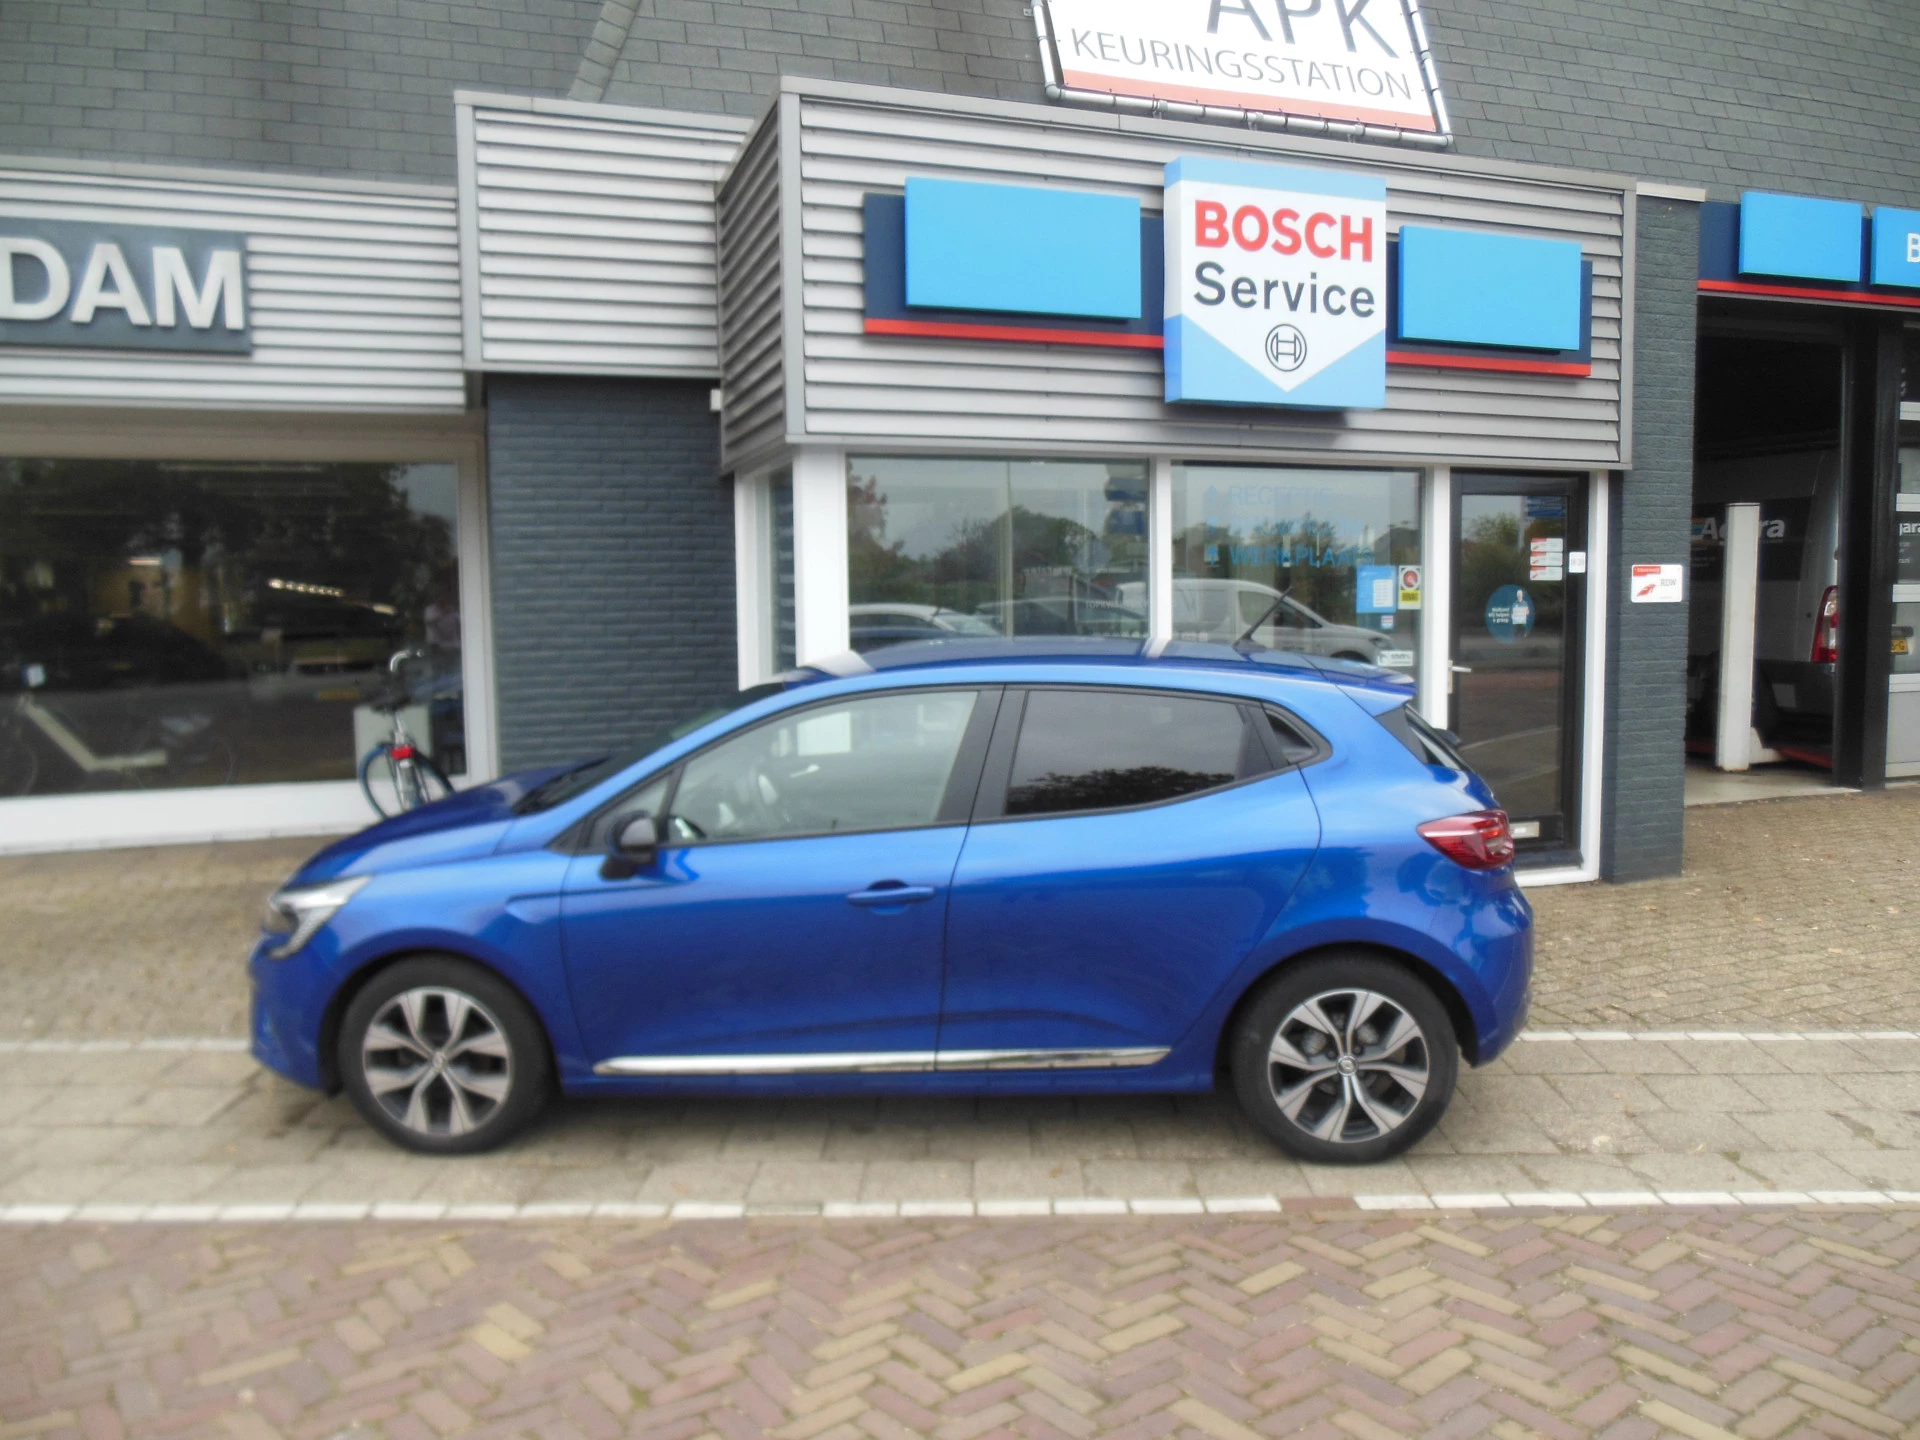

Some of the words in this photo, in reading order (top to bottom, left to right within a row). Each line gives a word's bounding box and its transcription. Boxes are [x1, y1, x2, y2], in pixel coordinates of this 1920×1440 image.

[1205, 0, 1399, 58] APK
[1070, 27, 1412, 100] KEURINGSSTATION
[1195, 199, 1372, 262] BOSCH
[0, 236, 245, 330] DAM
[1193, 260, 1375, 318] Service
